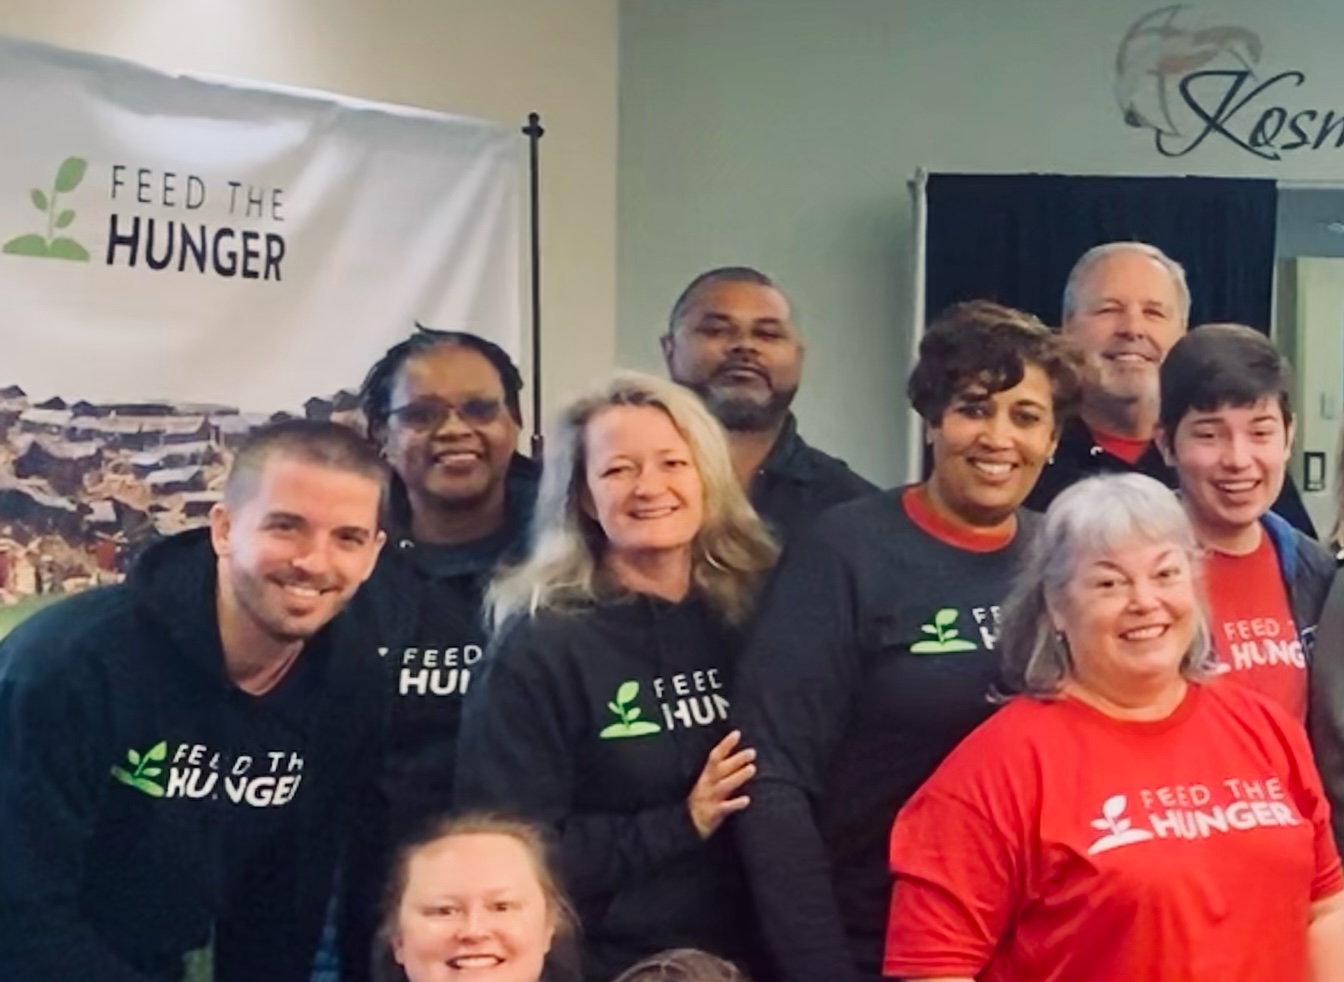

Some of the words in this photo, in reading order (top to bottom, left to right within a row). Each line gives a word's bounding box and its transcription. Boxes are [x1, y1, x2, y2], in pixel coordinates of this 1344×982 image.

[112, 165, 206, 210] FEED
[228, 181, 285, 221] THE
[106, 214, 286, 281] HUNGER
[1224, 617, 1280, 640] FEED
[403, 645, 483, 667] FEED
[1141, 784, 1211, 809] FEED
[1223, 777, 1285, 800] THE
[1149, 801, 1300, 839] HUNGER
